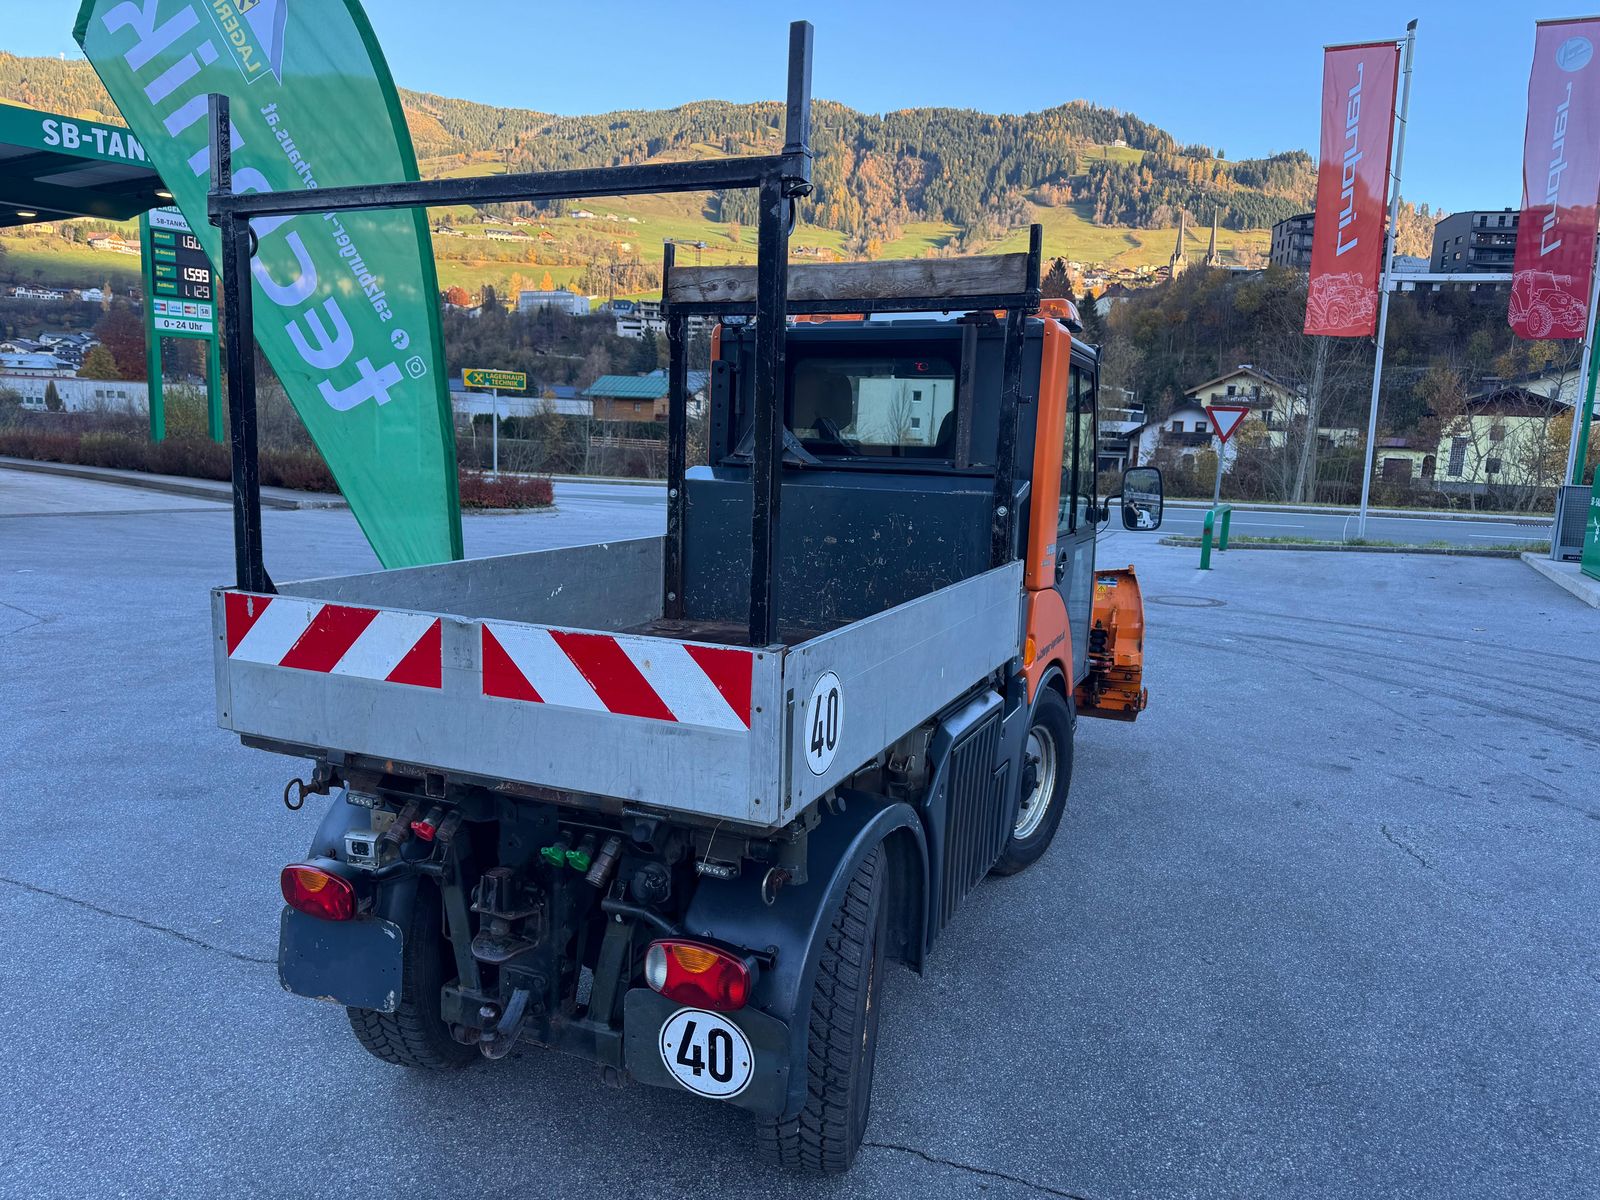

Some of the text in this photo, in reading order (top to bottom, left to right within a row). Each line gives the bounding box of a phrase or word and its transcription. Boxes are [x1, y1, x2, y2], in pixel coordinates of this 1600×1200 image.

[42, 119, 150, 162] SB-TAN
[164, 319, 170, 328] 0
[176, 320, 187, 329] 24
[188, 321, 203, 331] Uhr
[485, 373, 525, 381] LAGERHAUS
[491, 378, 519, 387] TECHNIK
[810, 687, 839, 758] 40
[676, 1020, 734, 1083] 40
